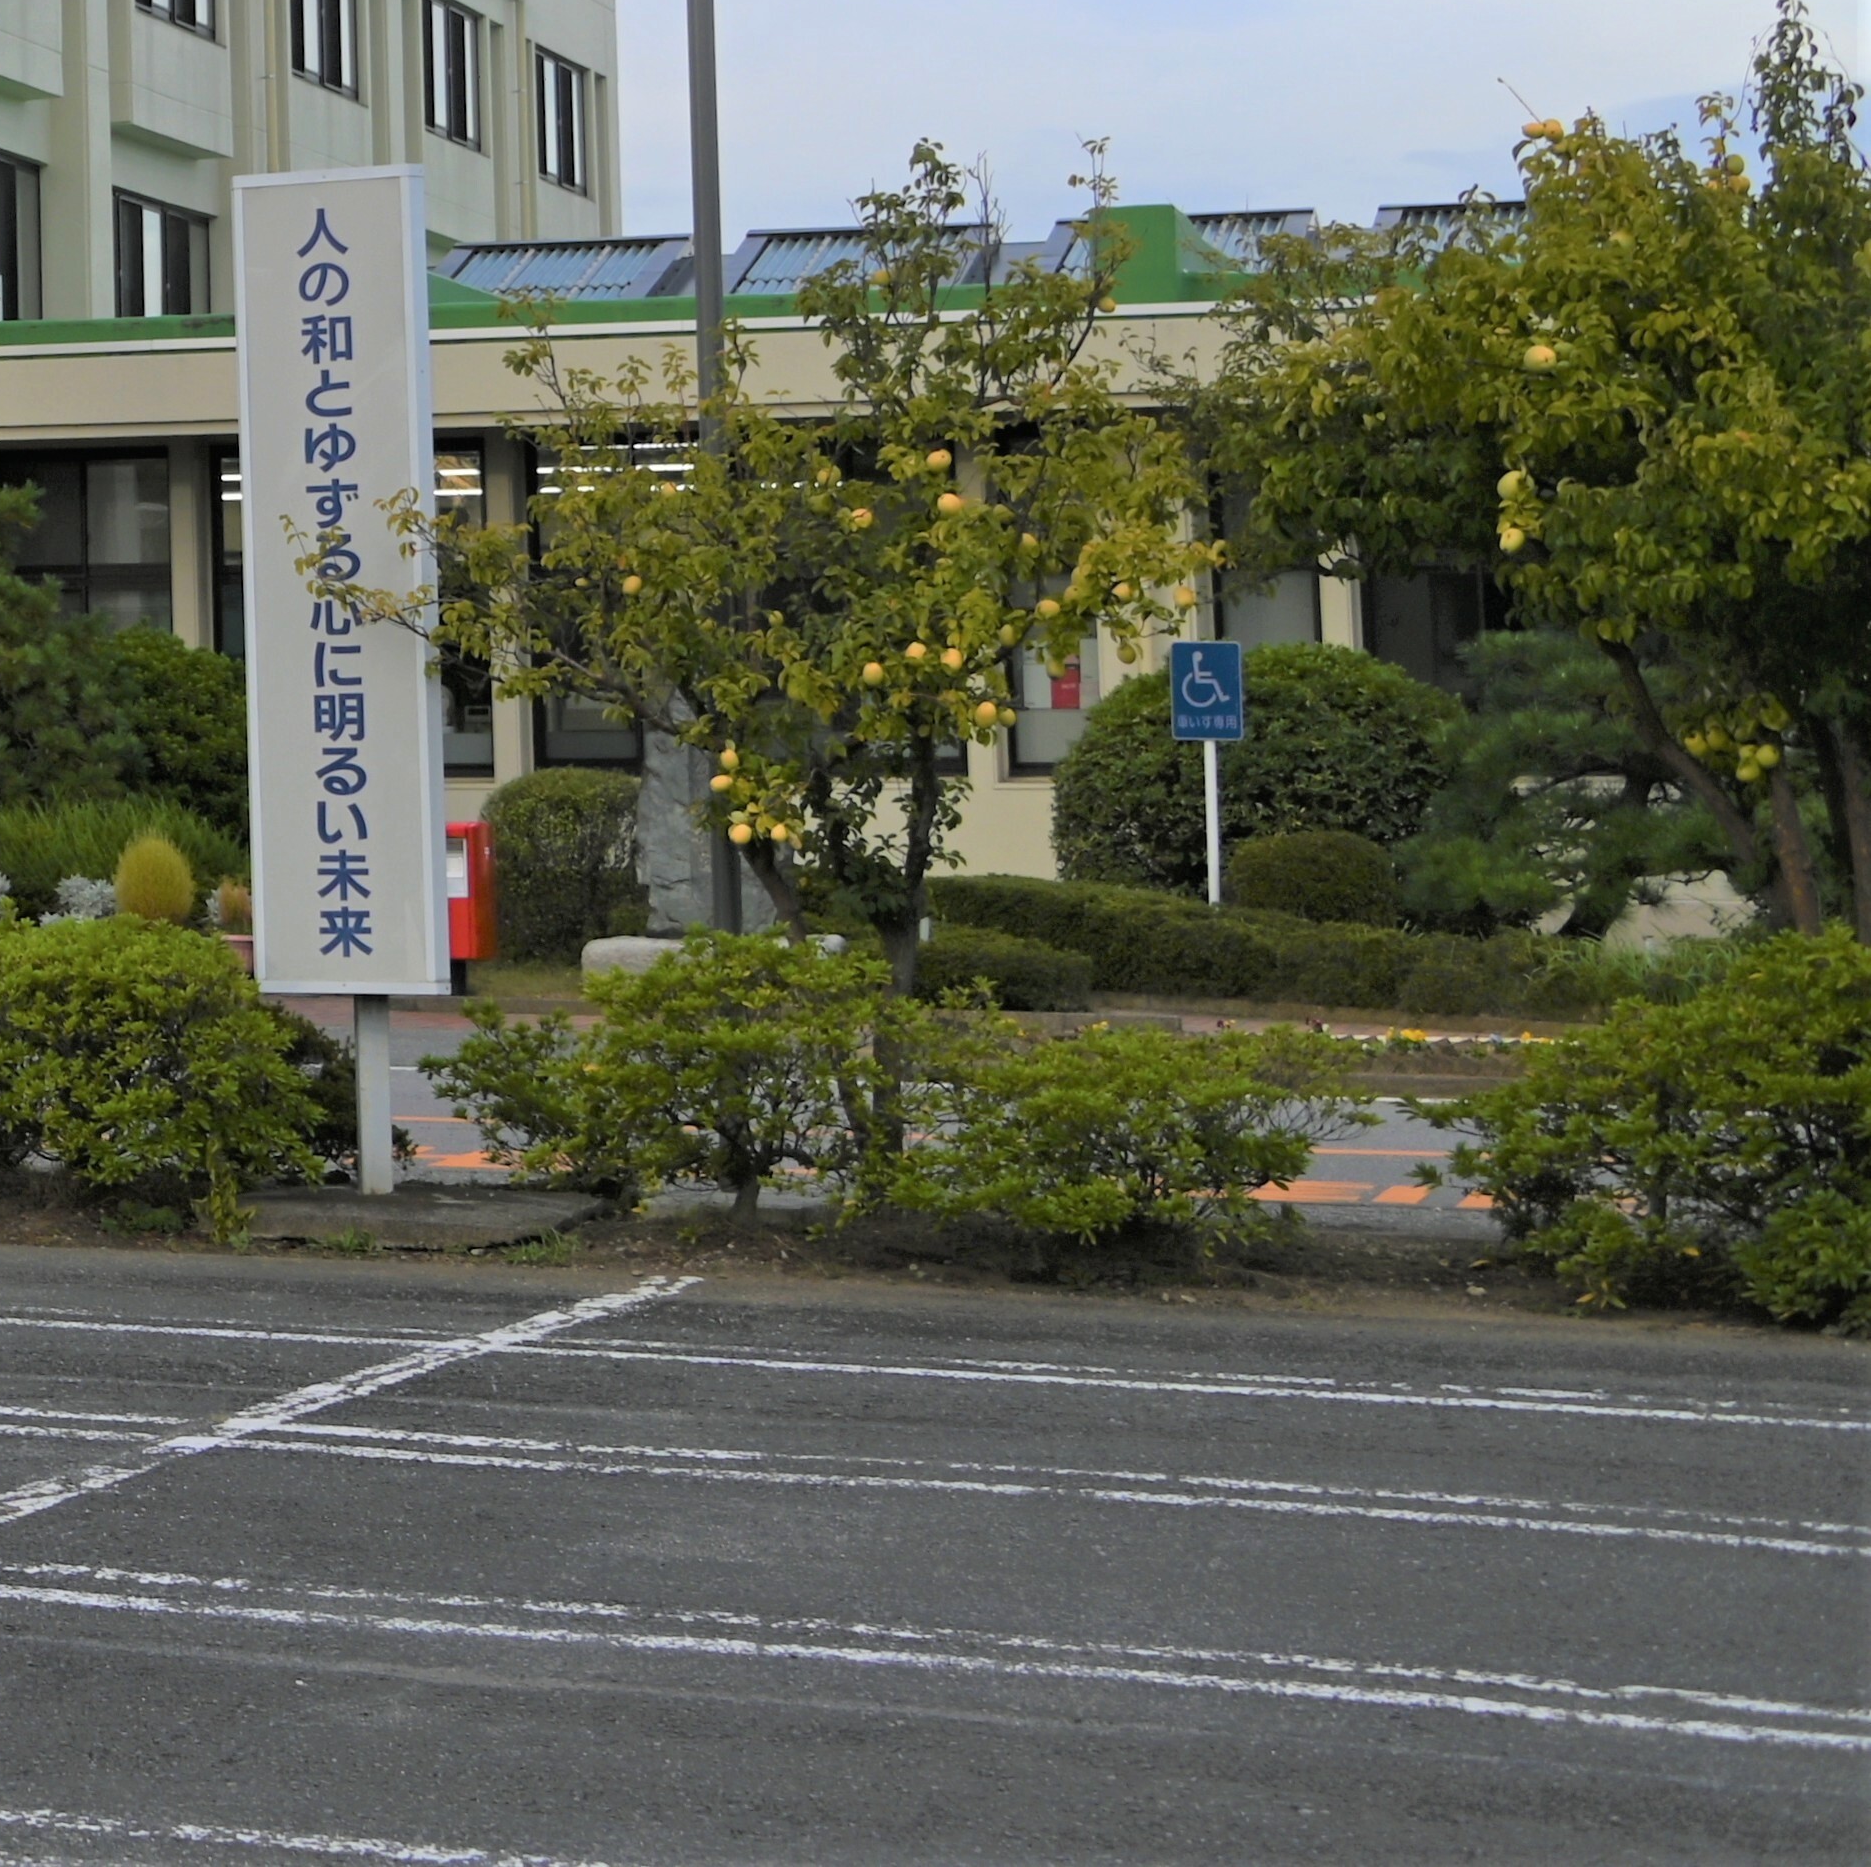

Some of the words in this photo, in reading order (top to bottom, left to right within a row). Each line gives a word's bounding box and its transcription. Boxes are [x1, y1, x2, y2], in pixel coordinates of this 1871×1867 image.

[296, 207, 373, 958] 人の和とゆずる心に明るい未来
[1177, 715, 1237, 730] 車いす専用
